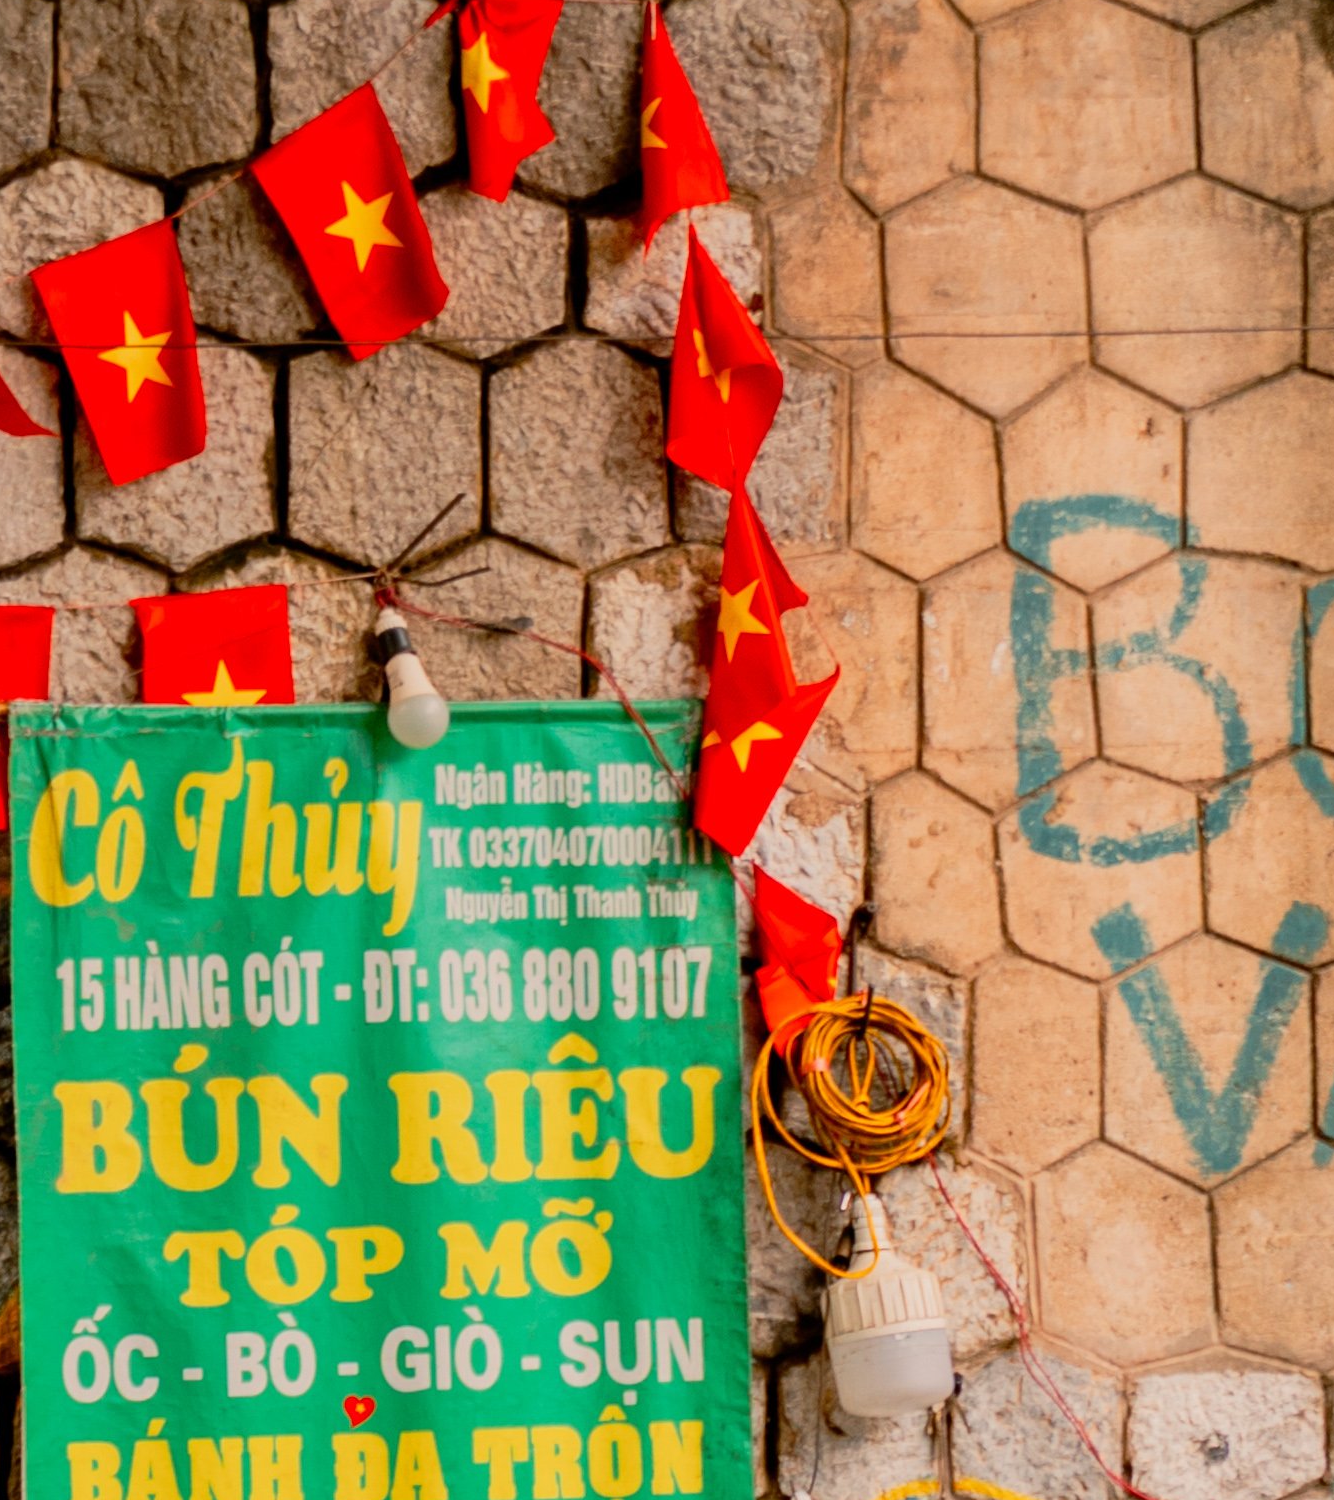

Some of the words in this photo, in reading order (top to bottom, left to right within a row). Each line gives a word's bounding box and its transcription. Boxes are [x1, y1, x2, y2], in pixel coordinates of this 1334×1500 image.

[434, 762, 507, 810] Ngân
[513, 761, 592, 809] Hàng:
[28, 758, 146, 908] Cô
[174, 736, 424, 937] Thủy
[428, 827, 464, 869] TK
[532, 884, 569, 927] Thị
[573, 884, 643, 919] Thanh
[55, 957, 106, 1032] 15
[114, 940, 232, 1031] HÀNG
[242, 936, 325, 1028] CÓT
[362, 948, 431, 1024] ĐT:
[438, 947, 514, 1023] 036
[522, 946, 601, 1023] 880
[611, 945, 714, 1022] 9107
[52, 1042, 350, 1195] BÚN
[387, 1030, 723, 1186] RIÊU
[162, 1203, 405, 1309] TÓP
[437, 1197, 615, 1301] MỠ
[61, 1303, 160, 1404] ỐC
[225, 1311, 318, 1399] BÒ
[380, 1305, 504, 1393] GIÒ
[558, 1317, 706, 1406] SỤN
